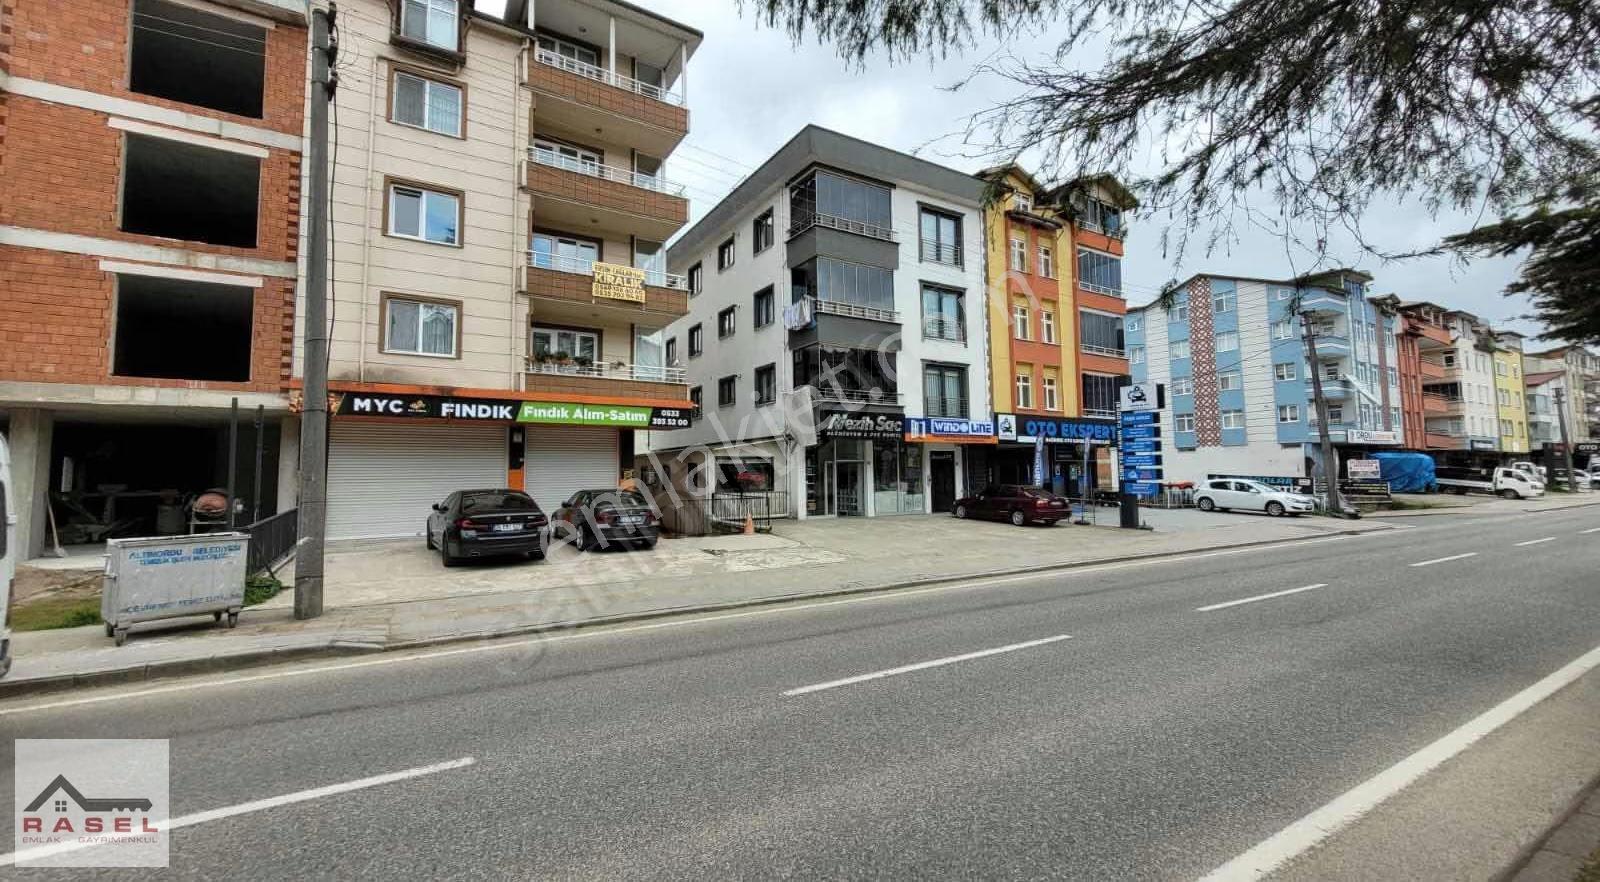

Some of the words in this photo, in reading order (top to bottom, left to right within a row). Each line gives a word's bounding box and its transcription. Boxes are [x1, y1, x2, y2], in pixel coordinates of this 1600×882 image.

[353, 398, 403, 412] MYC
[441, 402, 513, 419] FINDIK
[523, 405, 569, 419] Fındık
[573, 407, 647, 422] Alım-Satım
[1025, 420, 1057, 437] OTO
